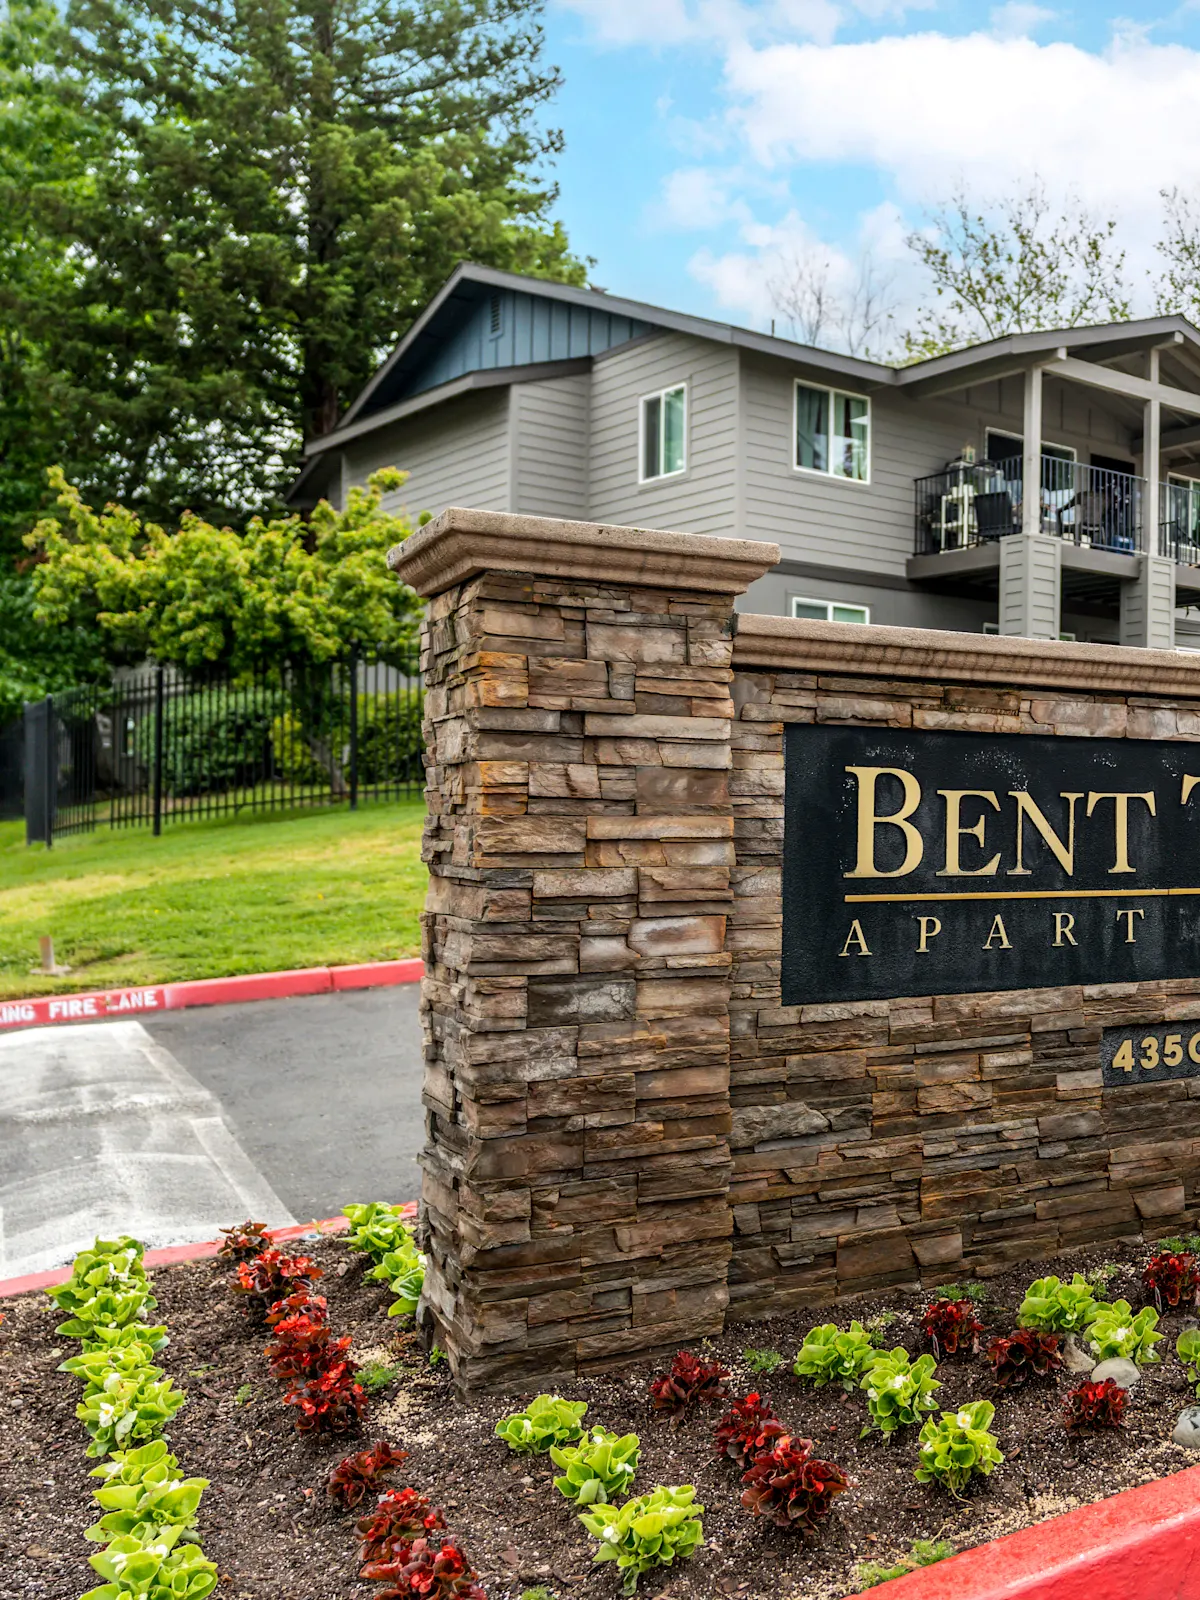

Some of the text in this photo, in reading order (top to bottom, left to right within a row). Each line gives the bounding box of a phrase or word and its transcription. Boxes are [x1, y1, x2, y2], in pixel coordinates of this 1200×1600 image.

[843, 765, 1157, 879] BENT
[48, 997, 98, 1020] FIRE
[106, 989, 158, 1011] LANE
